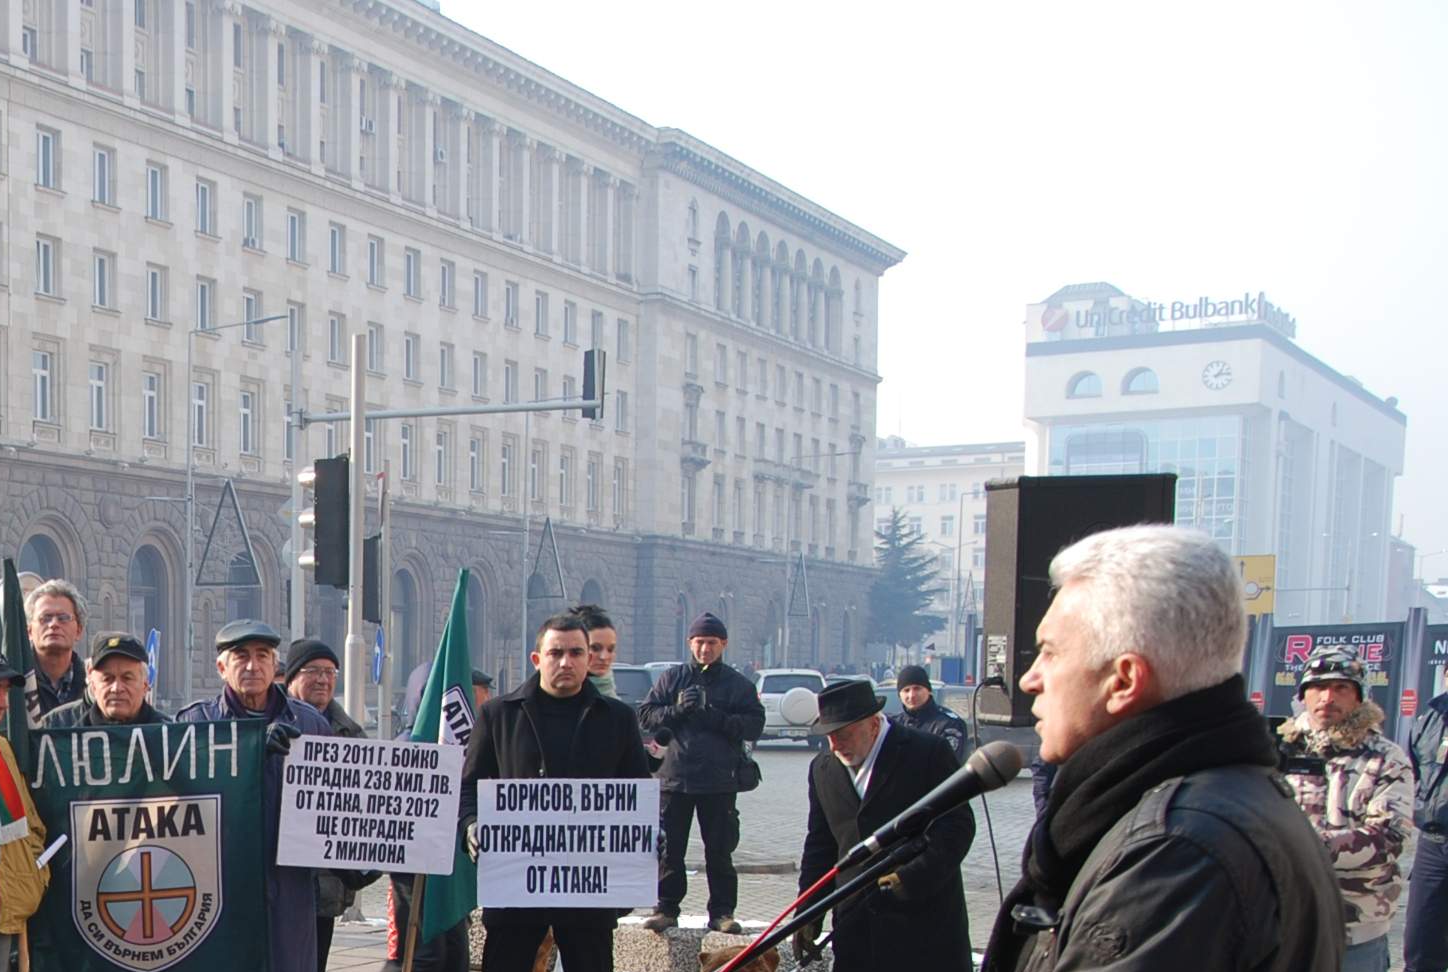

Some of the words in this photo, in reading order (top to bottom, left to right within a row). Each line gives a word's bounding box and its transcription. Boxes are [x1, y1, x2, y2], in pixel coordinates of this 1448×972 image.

[1076, 300, 1166, 329] UniCredit
[1170, 292, 1256, 321] Bulbank
[1317, 636, 1346, 645] FOLK
[1352, 634, 1385, 643] CLUB
[31, 721, 238, 789] ЛЮЛИН
[304, 741, 339, 763] ПРЕЗ
[342, 744, 374, 765] 2011
[377, 746, 388, 766] Г.
[391, 745, 439, 770] БОЙКО
[286, 765, 361, 790] ОТКРАДНА
[364, 769, 392, 791] 238
[394, 773, 426, 794] ХИЛ.
[428, 775, 453, 796] ЛВ.
[295, 789, 314, 810] ОТ
[315, 790, 363, 815] АТАКА,
[366, 794, 402, 816] ПРЕЗ
[404, 798, 440, 819] 2012
[496, 783, 577, 814] БОРИСОВ,
[581, 783, 637, 812] ВЪРНИ
[88, 803, 206, 842] АТАКА
[316, 815, 338, 839] ЩЕ
[341, 817, 415, 843] ОТКРАДНЕ
[324, 840, 332, 860] 2
[336, 841, 406, 864] МИЛИОНА
[480, 824, 605, 857] ОТКРАДНАТИТЕ
[609, 824, 653, 853] ПАРИ
[526, 865, 547, 894] ОТ
[550, 865, 608, 894] АТАКА!
[80, 899, 93, 922] ДА
[87, 922, 105, 943] СИ
[103, 936, 163, 962] ВЪРНЕМ
[167, 892, 213, 956] БЪЛГАРИЯ
